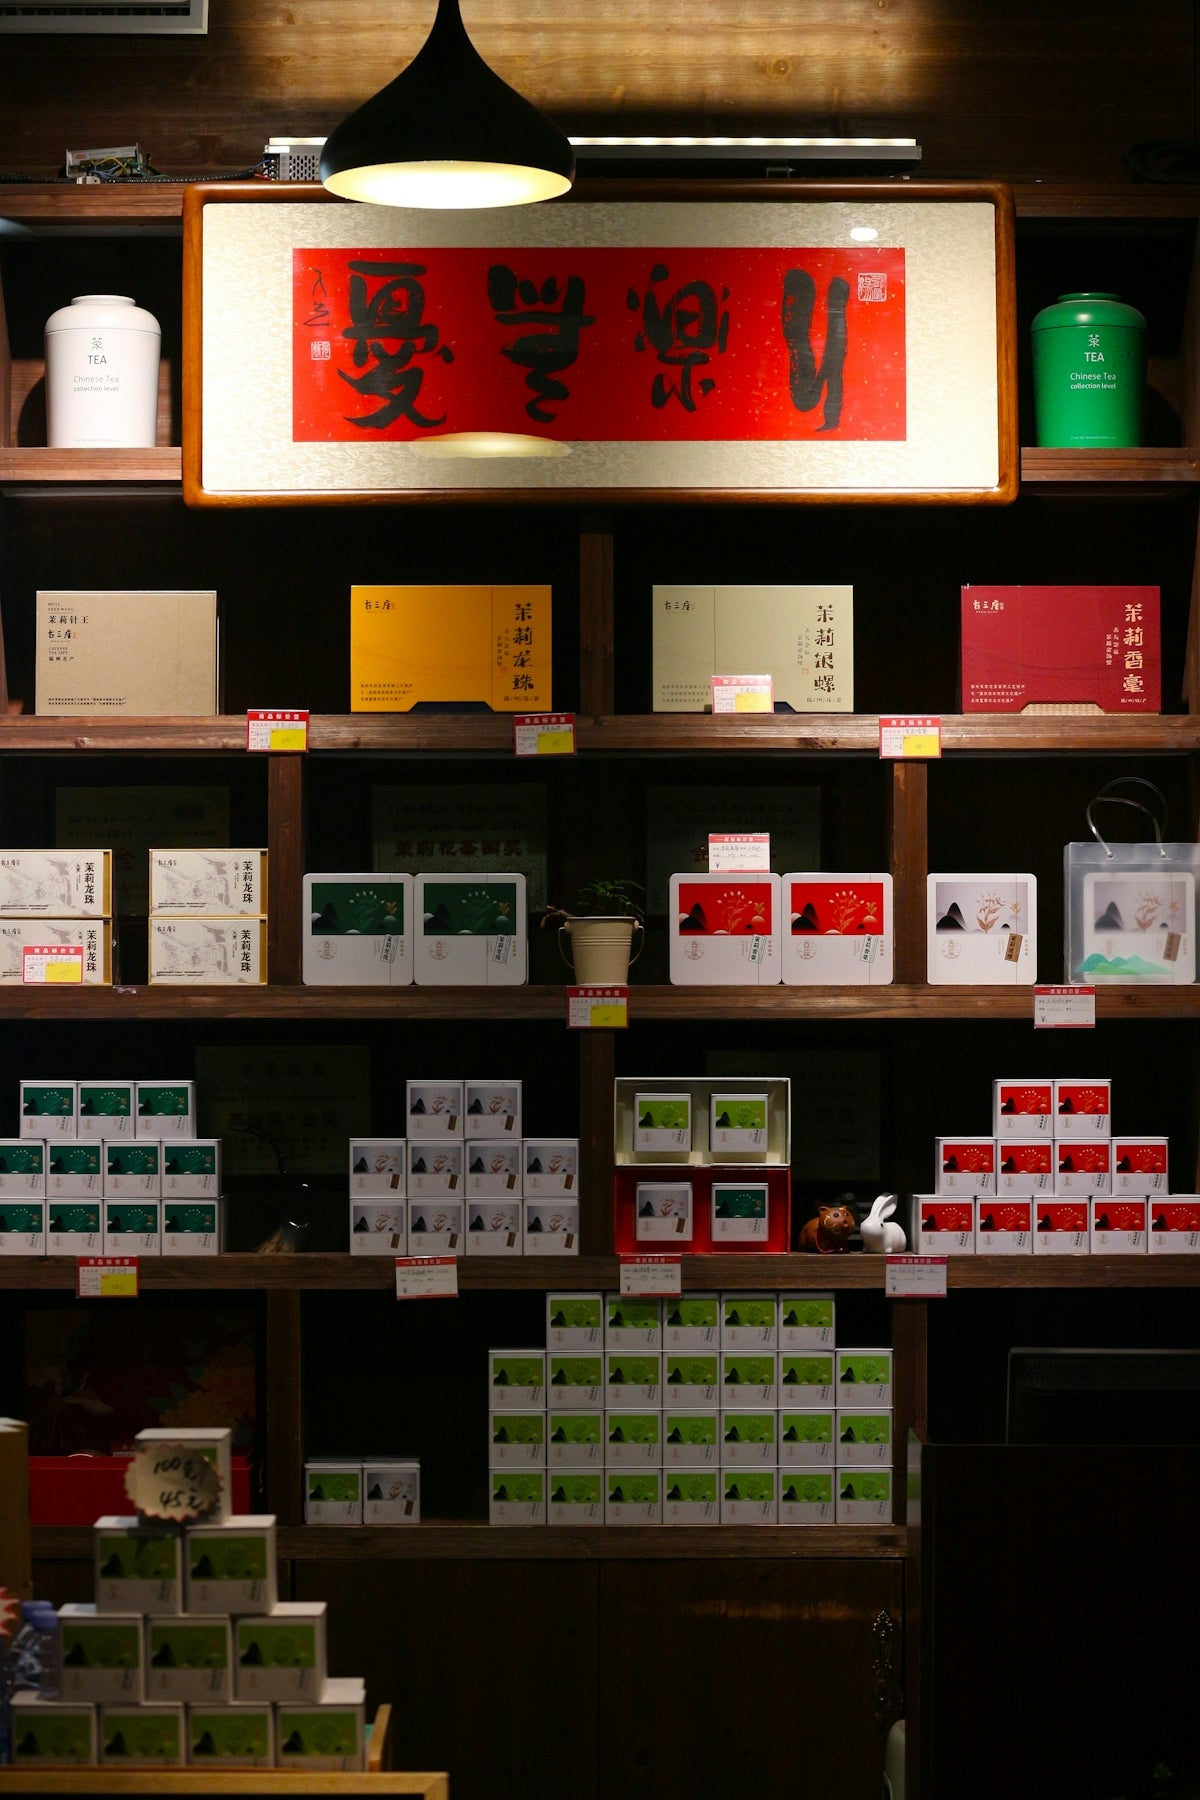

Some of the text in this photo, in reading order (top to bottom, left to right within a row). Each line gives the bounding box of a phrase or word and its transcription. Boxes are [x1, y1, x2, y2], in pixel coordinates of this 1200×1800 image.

[91, 337, 103, 350] 茶
[1088, 334, 1100, 347] 茶
[88, 355, 107, 365] TEA
[1084, 352, 1104, 362] TEA
[73, 375, 119, 383] Chinese Tea
[1070, 372, 1117, 380] Chinese Tea
[48, 615, 89, 624] 茉莉针王
[512, 602, 534, 691] 茉莉龙珠
[813, 604, 835, 693] 茉莉银螺
[1122, 603, 1145, 694] 茉莉香毫
[84, 862, 95, 905] 茉莉龙珠
[242, 861, 253, 903] 茉莉龙珠
[86, 930, 97, 972] 茉莉龙珠
[241, 930, 251, 972] 茉莉龙珠
